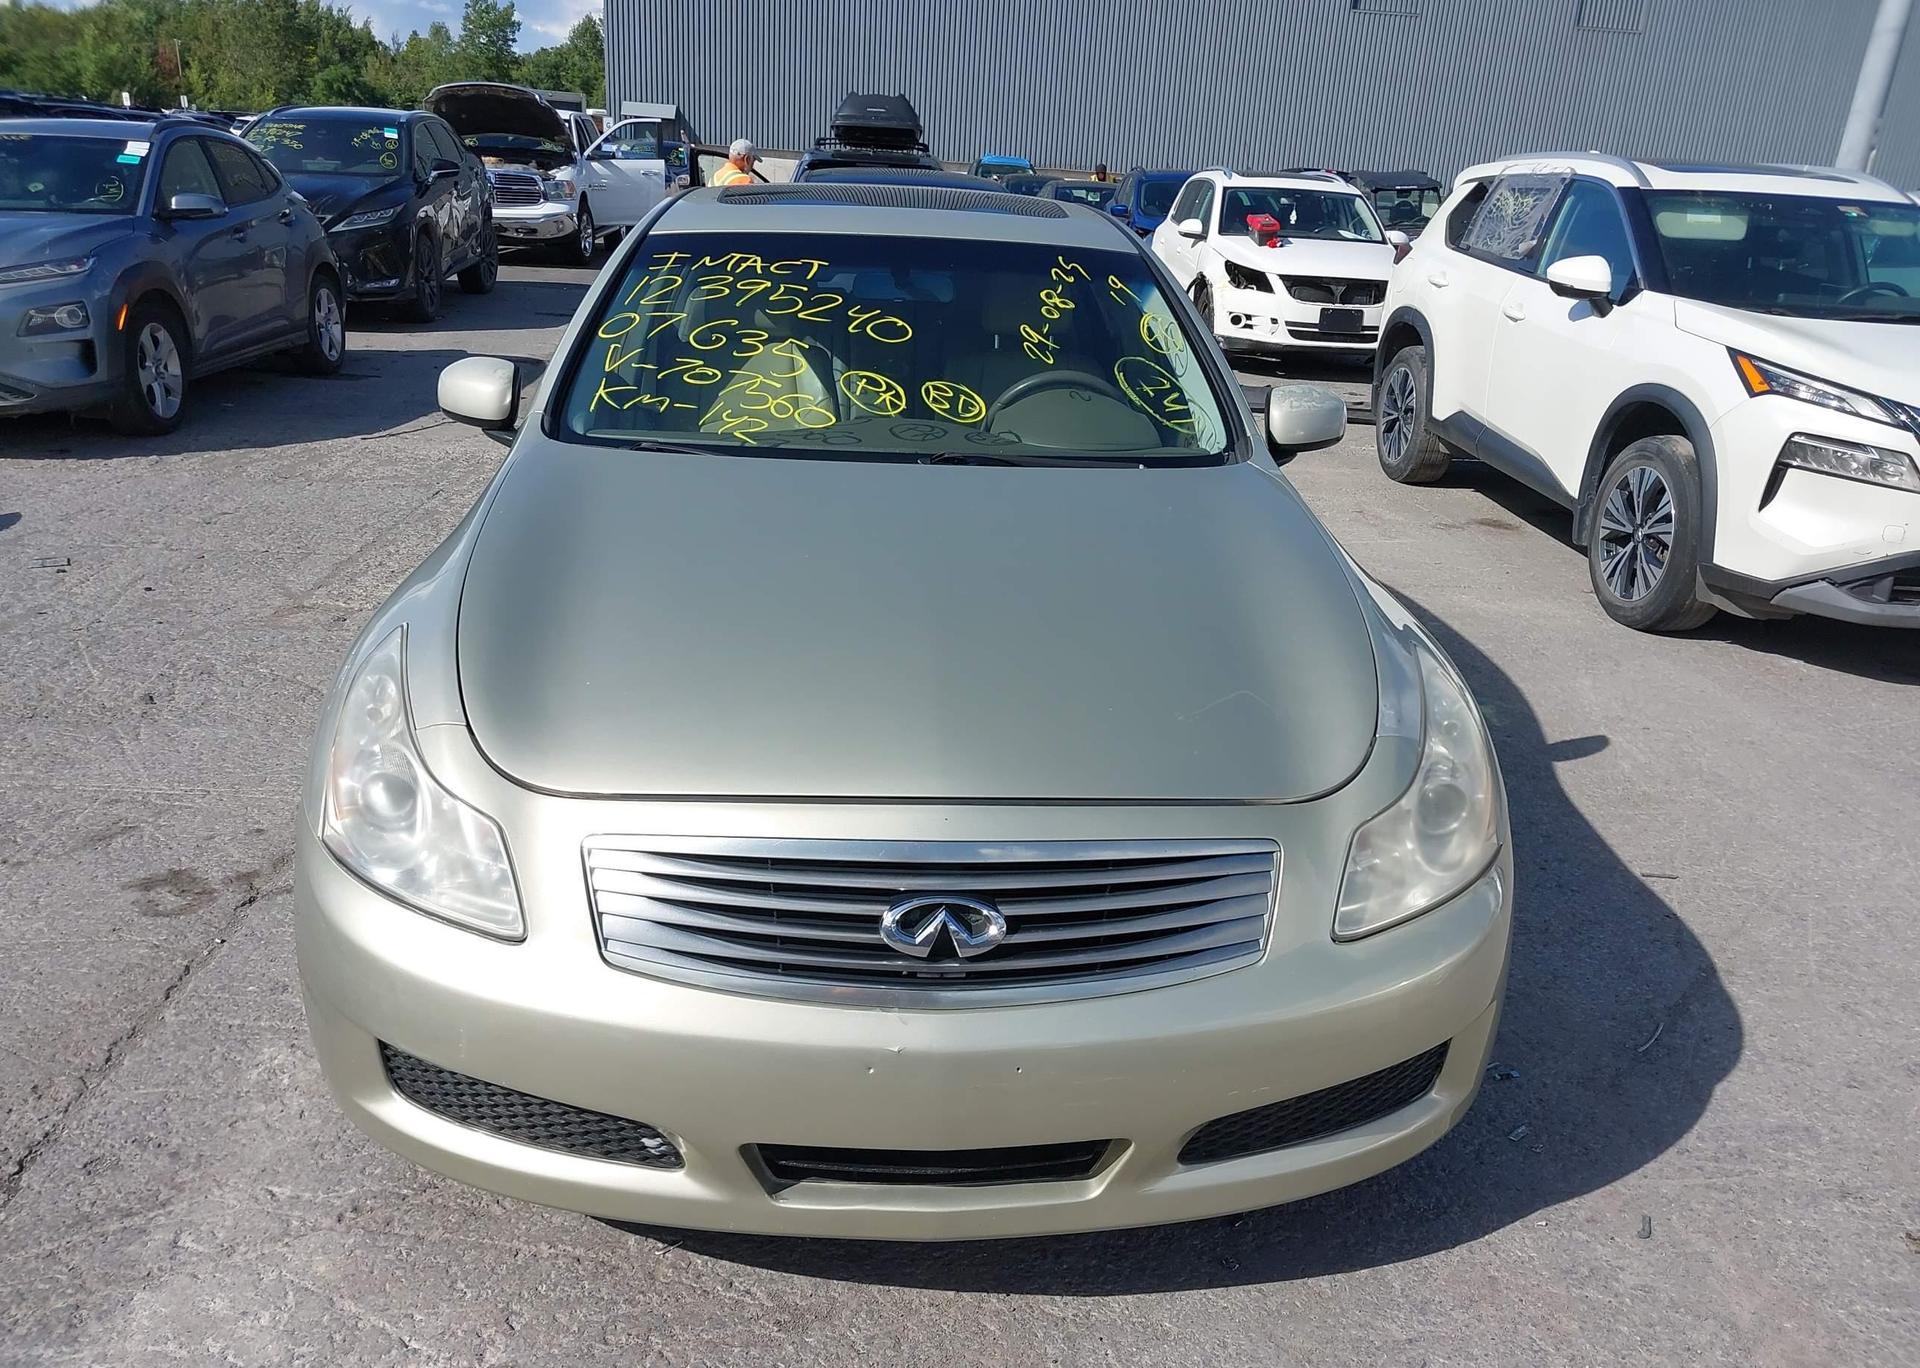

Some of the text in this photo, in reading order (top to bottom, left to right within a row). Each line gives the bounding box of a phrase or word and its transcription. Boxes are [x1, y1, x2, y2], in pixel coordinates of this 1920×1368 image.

[649, 252, 829, 279] INTACT
[624, 276, 913, 343] 12395240
[1019, 256, 1091, 364] 29-08-25
[598, 312, 810, 378] 07 G35
